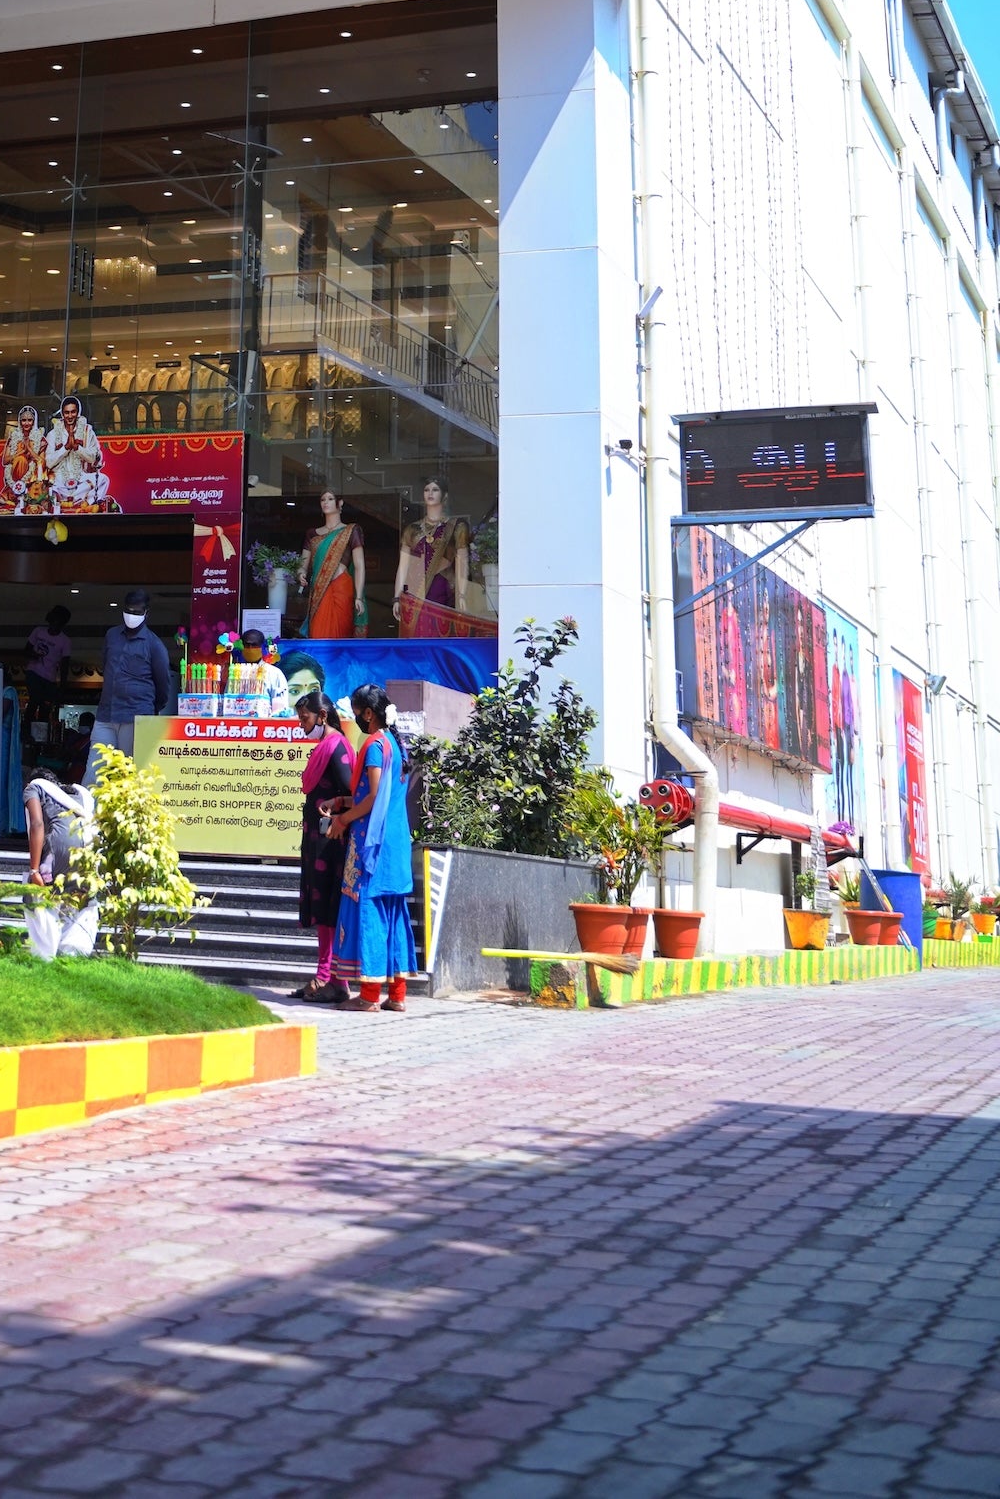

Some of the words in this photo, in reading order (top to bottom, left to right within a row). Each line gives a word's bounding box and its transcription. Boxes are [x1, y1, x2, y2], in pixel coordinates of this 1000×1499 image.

[184, 721, 258, 739] டோக்கன்
[158, 744, 283, 760] வாடிக்கையாளர்களுக்கு
[180, 765, 272, 777] வாடிக்கையாளர்கள்
[161, 781, 201, 793] தாங்கள்
[203, 782, 280, 797] வெளியிலிருந்து
[219, 800, 262, 809] SHOPPER
[205, 815, 263, 827] கொண்டுவர
